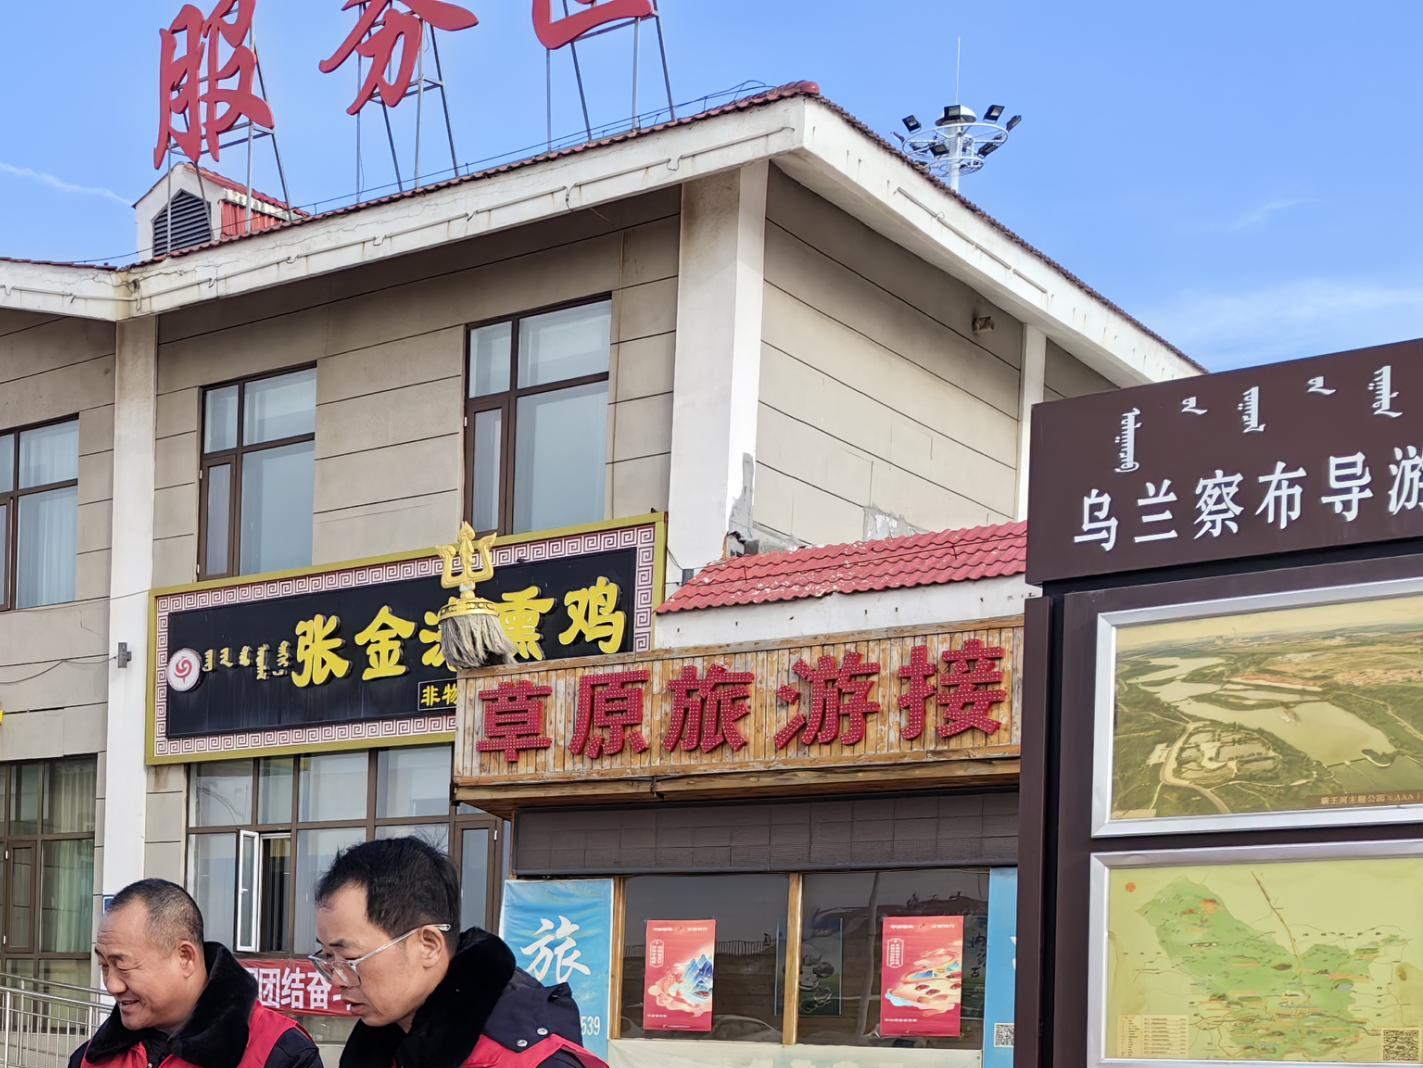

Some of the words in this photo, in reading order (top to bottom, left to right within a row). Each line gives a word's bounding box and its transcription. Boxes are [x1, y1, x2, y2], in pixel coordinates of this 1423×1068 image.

[476, 639, 1007, 763] 草原旅游接
[520, 915, 592, 984] 旅
